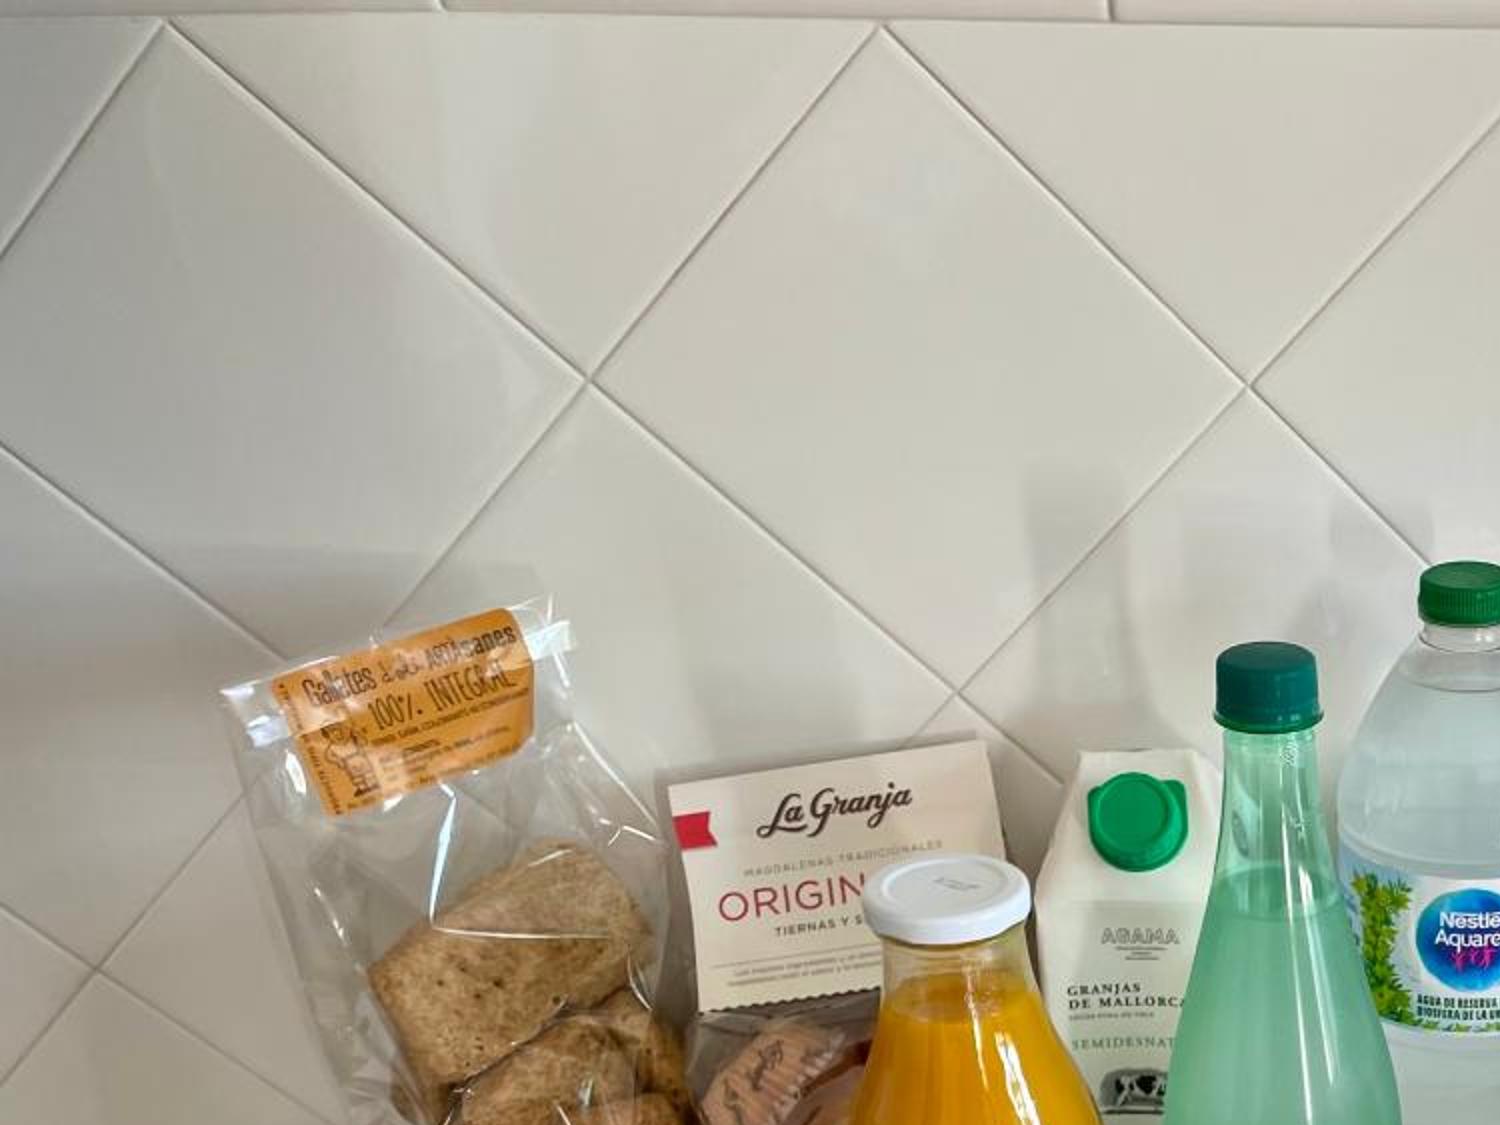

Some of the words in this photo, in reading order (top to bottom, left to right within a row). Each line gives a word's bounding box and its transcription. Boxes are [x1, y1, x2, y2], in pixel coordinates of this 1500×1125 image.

[757, 793, 808, 838] La
[807, 783, 912, 837] Granja
[718, 872, 865, 922] ORIGIN
[774, 918, 836, 937] TIERNAS
[841, 916, 850, 927] Y
[1066, 983, 1141, 996] GRANJAS
[1069, 999, 1091, 1010] DE
[1072, 1036, 1175, 1050] SEMIDESNAT
